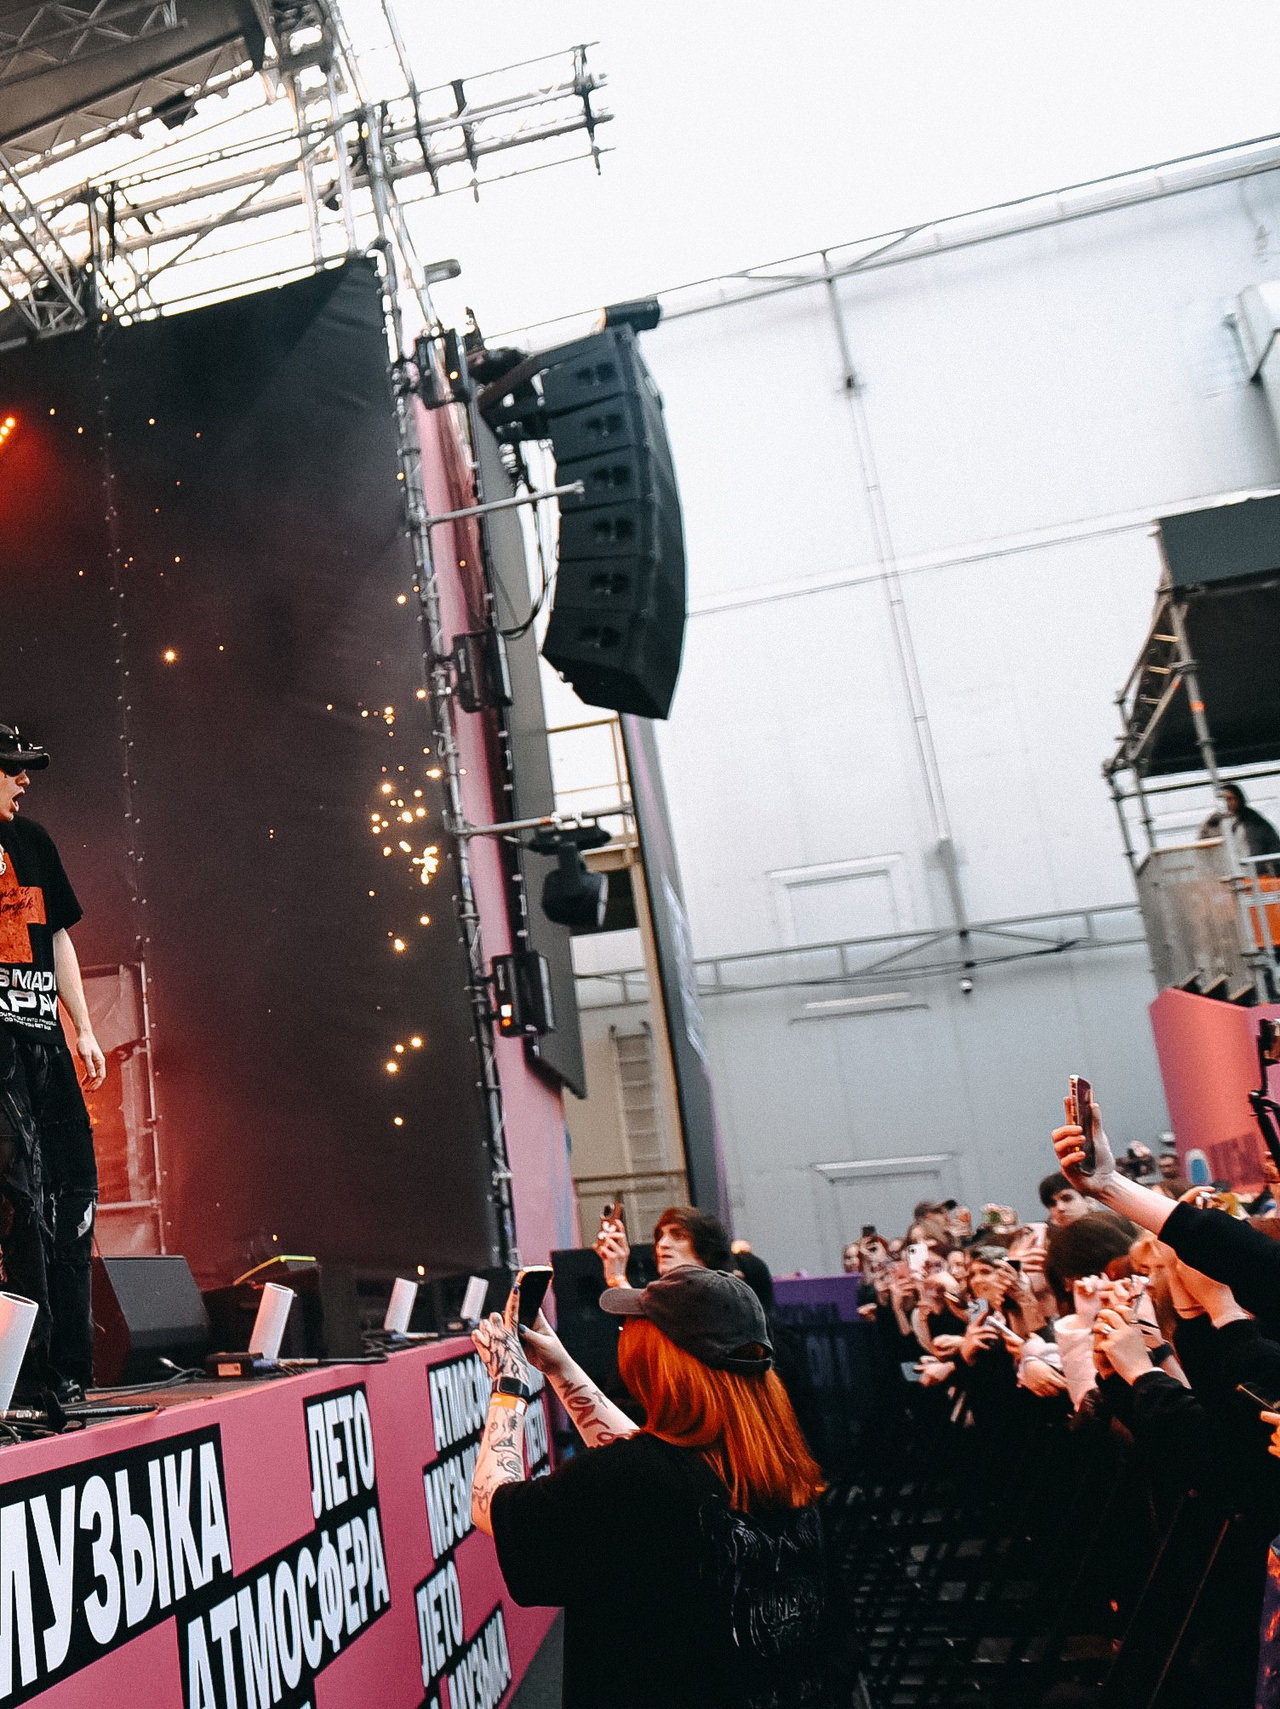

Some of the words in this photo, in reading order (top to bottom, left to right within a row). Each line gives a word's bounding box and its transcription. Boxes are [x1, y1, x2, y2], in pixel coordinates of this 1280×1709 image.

[307, 1389, 376, 1519] ЛЕТО
[187, 1507, 390, 1709] АТМОСФЕРА
[416, 1560, 463, 1688] ЛЕТО
